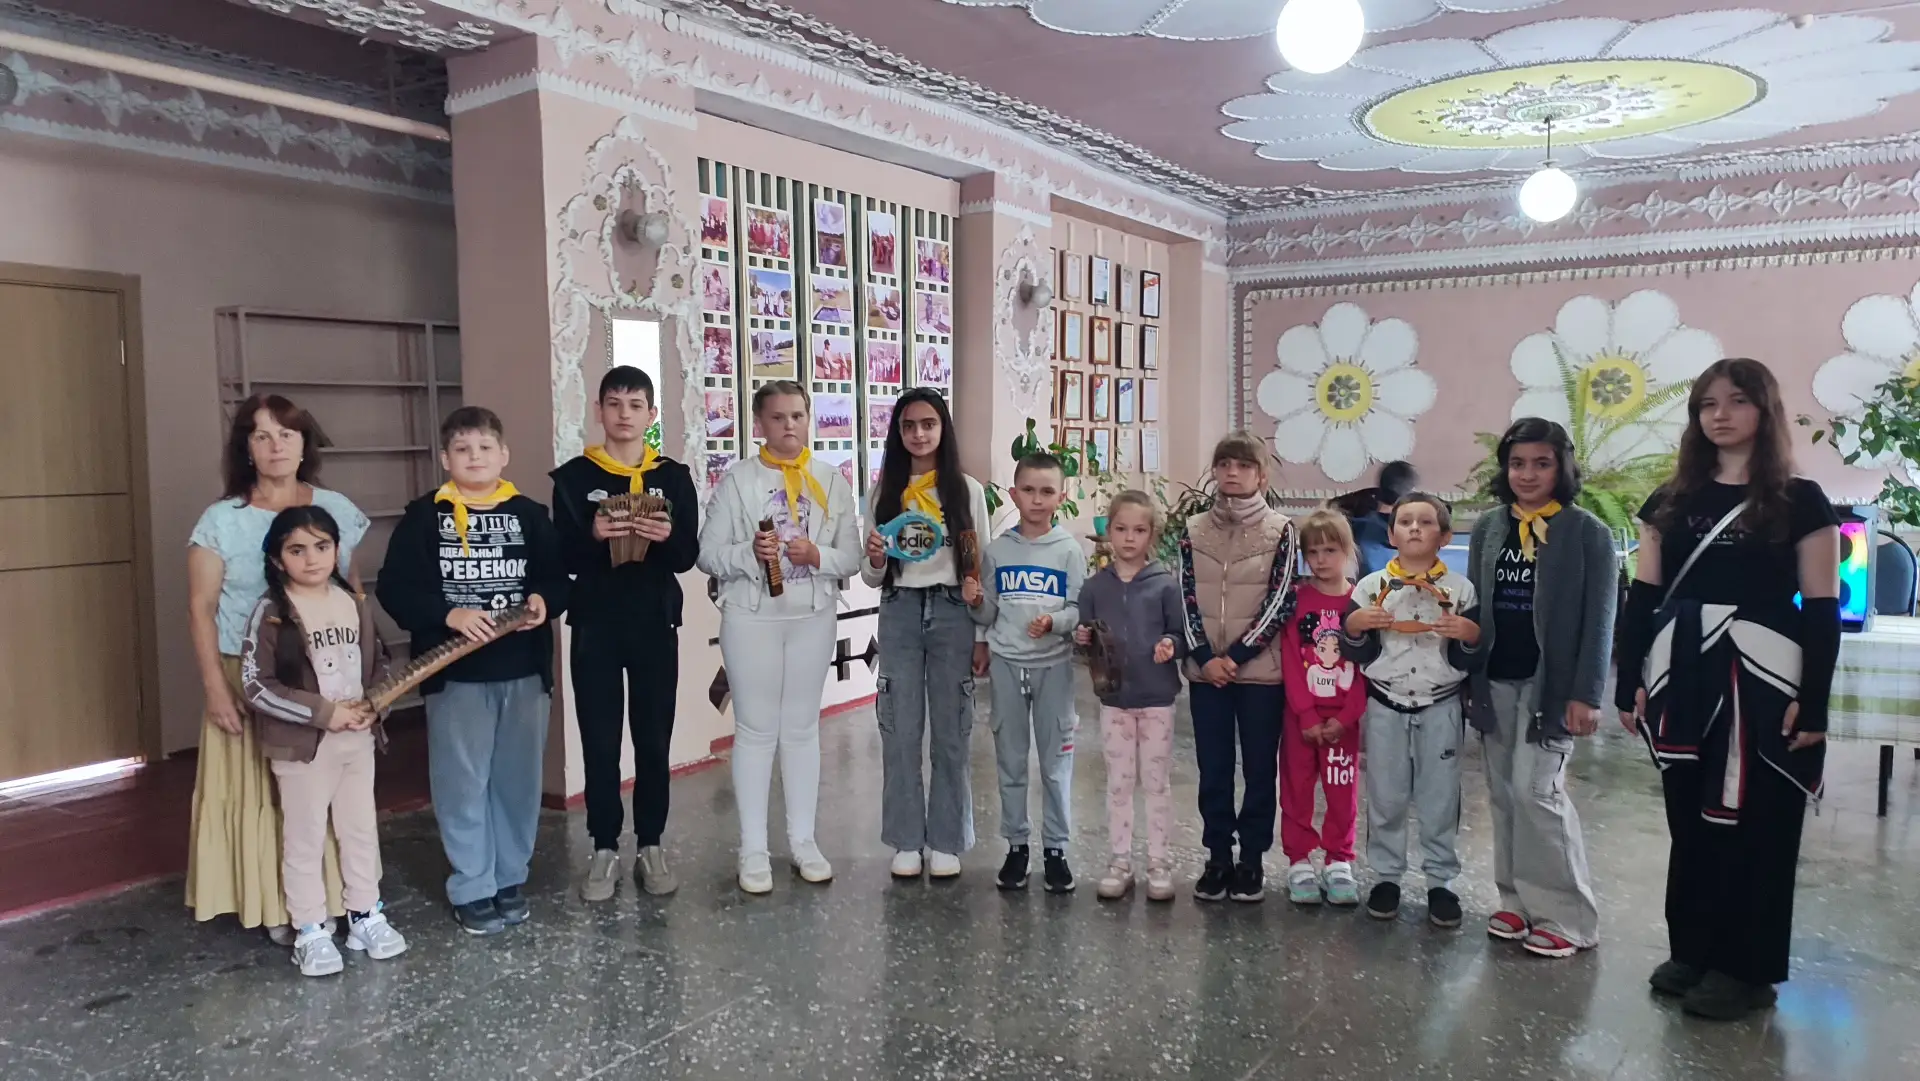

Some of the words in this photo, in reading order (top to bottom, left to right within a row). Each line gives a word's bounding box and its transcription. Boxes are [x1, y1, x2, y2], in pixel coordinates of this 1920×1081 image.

[439, 558, 528, 580] РЕБЕНОК
[1001, 570, 1059, 595] NASA
[307, 627, 358, 650] RIEND
[1316, 677, 1336, 686] LOVE
